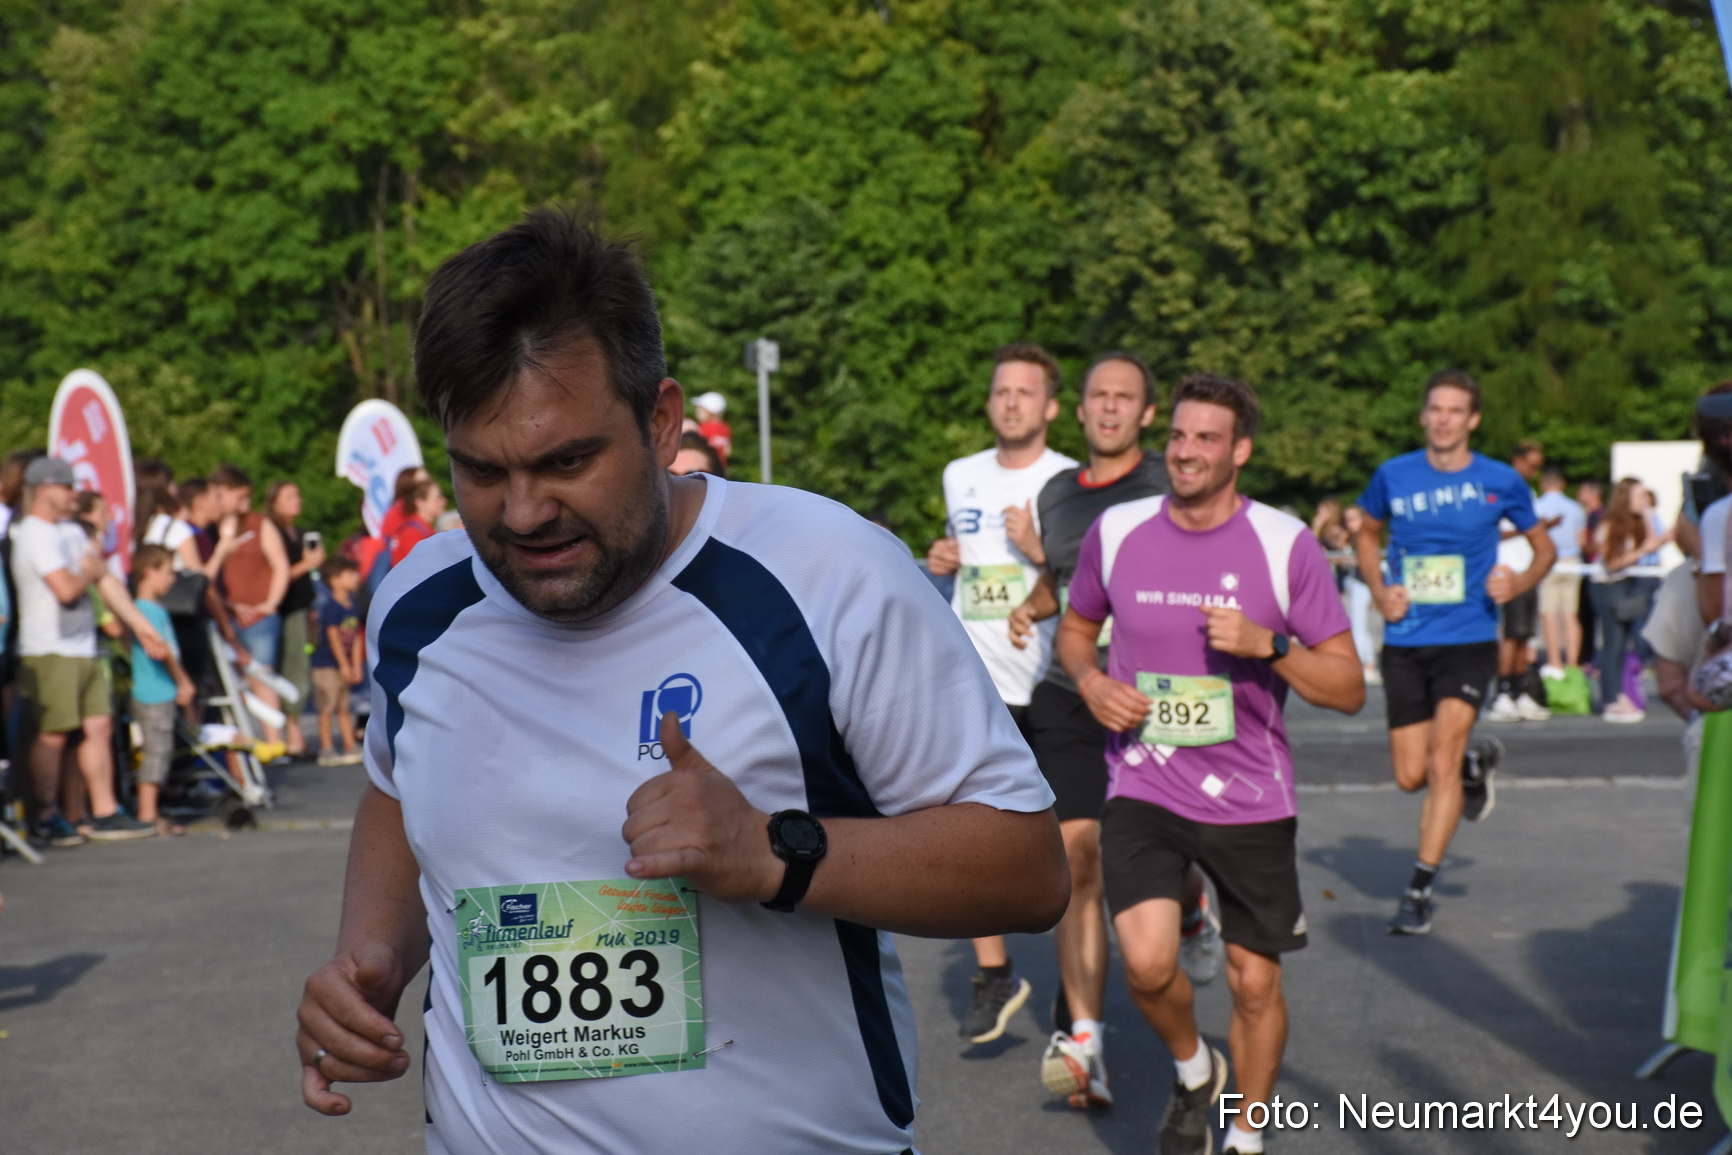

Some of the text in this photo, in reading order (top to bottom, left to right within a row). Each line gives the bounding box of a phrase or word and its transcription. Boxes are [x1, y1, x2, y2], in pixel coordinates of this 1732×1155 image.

[971, 583, 1009, 604] 344
[1135, 590, 1164, 604] WIR
[1166, 591, 1203, 607] SIND
[1158, 700, 1211, 725] 892
[486, 918, 575, 942] firmenlauf
[633, 929, 680, 946] 2019
[484, 949, 665, 1025] 1883
[500, 1025, 646, 1049] Weigert Markus
[505, 1043, 639, 1062] Pohl GmbH & Co. KG
